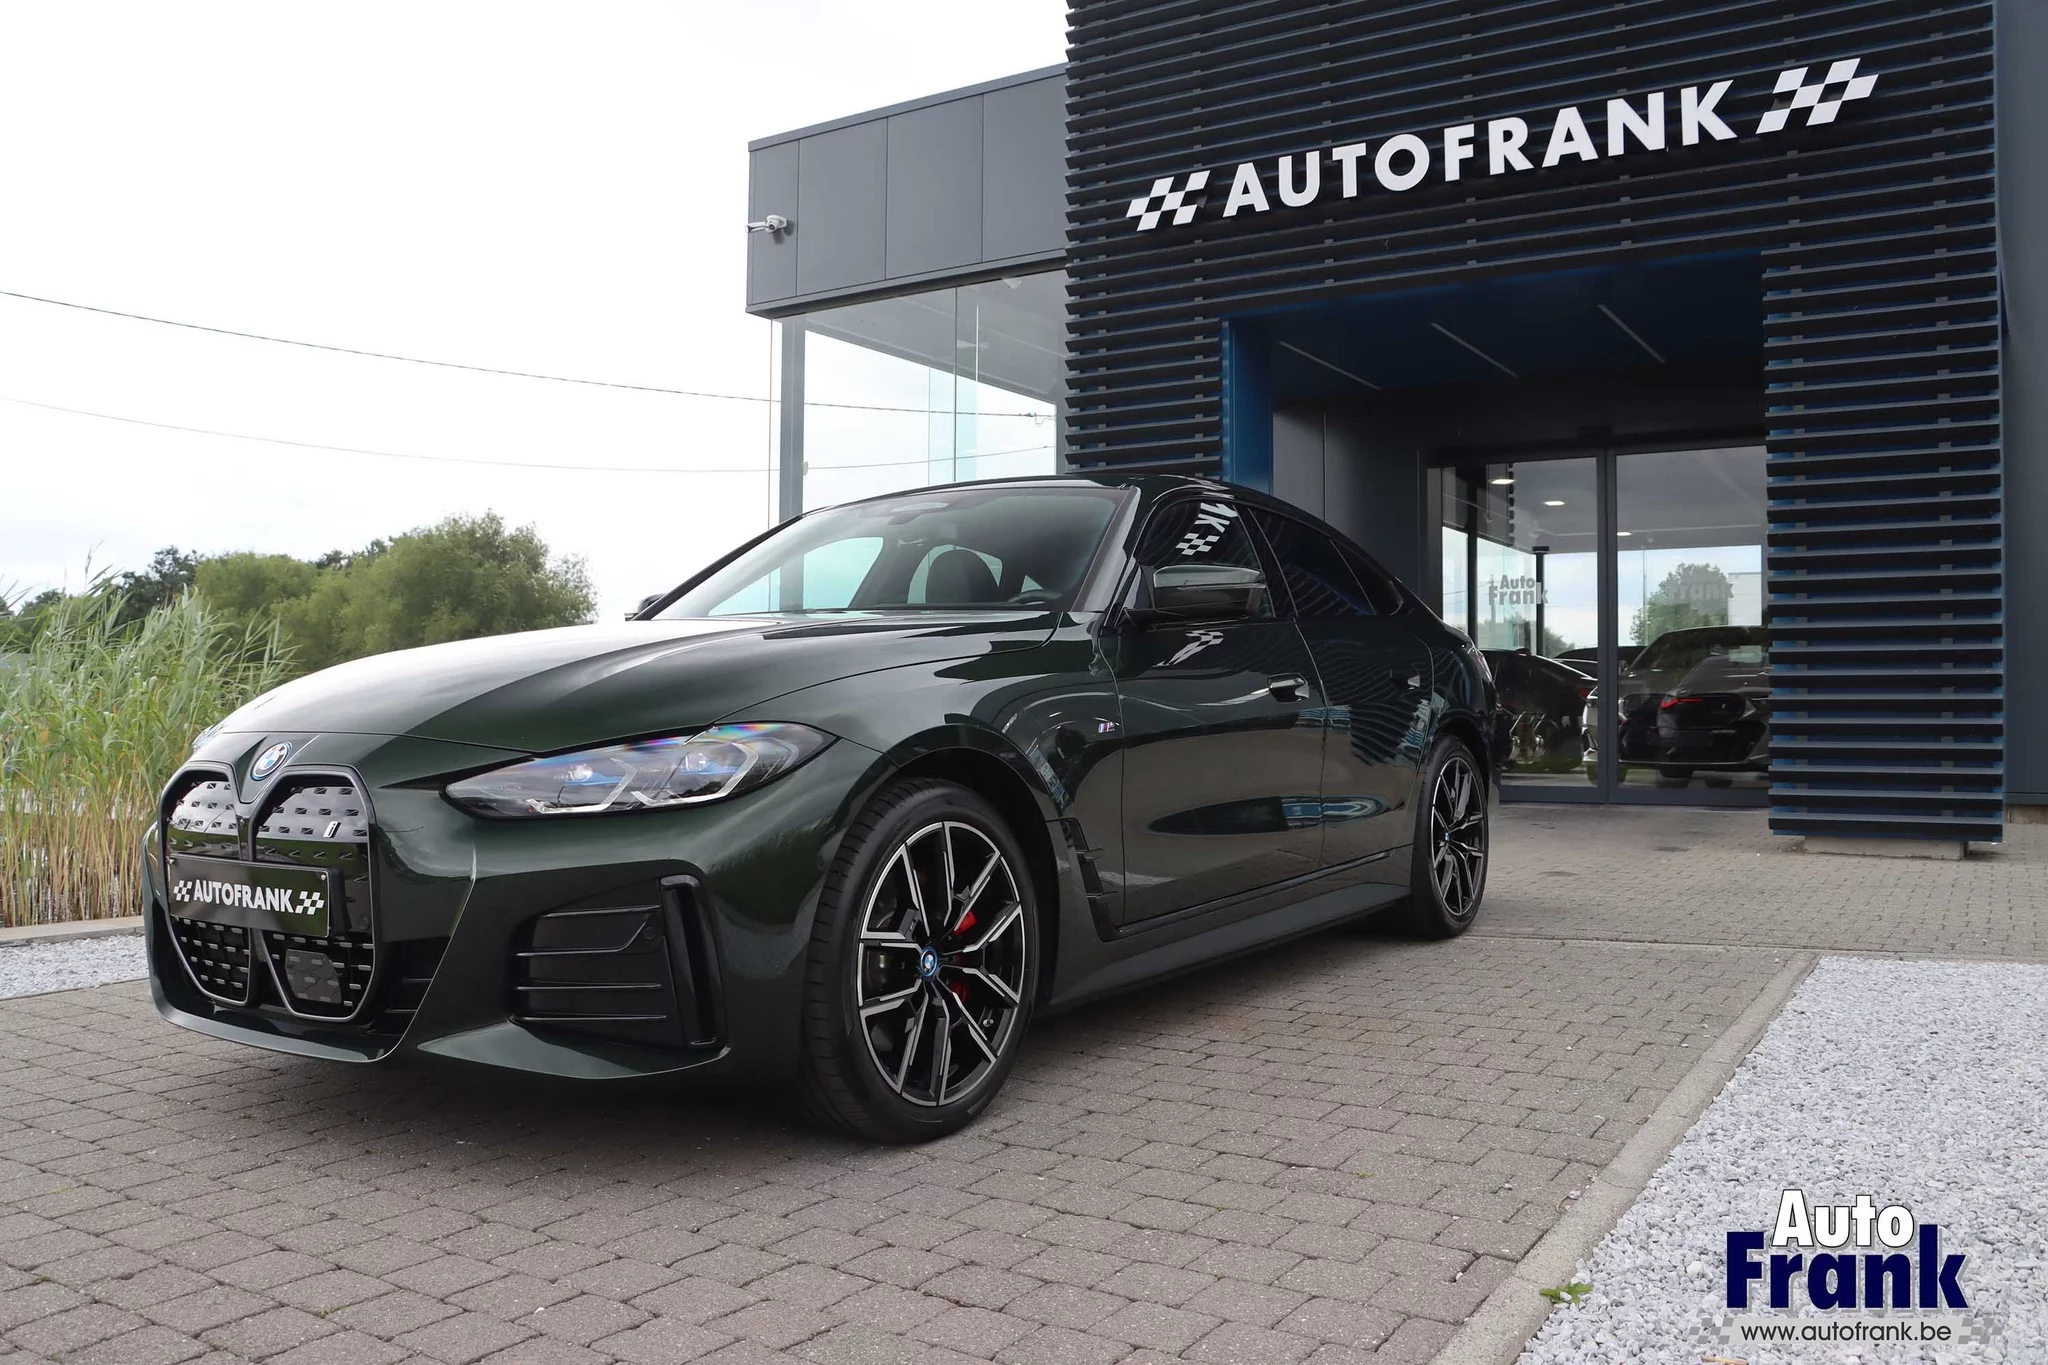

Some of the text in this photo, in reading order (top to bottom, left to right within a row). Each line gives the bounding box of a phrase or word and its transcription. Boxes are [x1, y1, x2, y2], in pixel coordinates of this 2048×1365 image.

[1223, 80, 1737, 218] AUTOFRANK
[1488, 582, 1549, 606] Frank
[1500, 574, 1536, 589] Auto
[194, 879, 294, 913] AUTOFRANK
